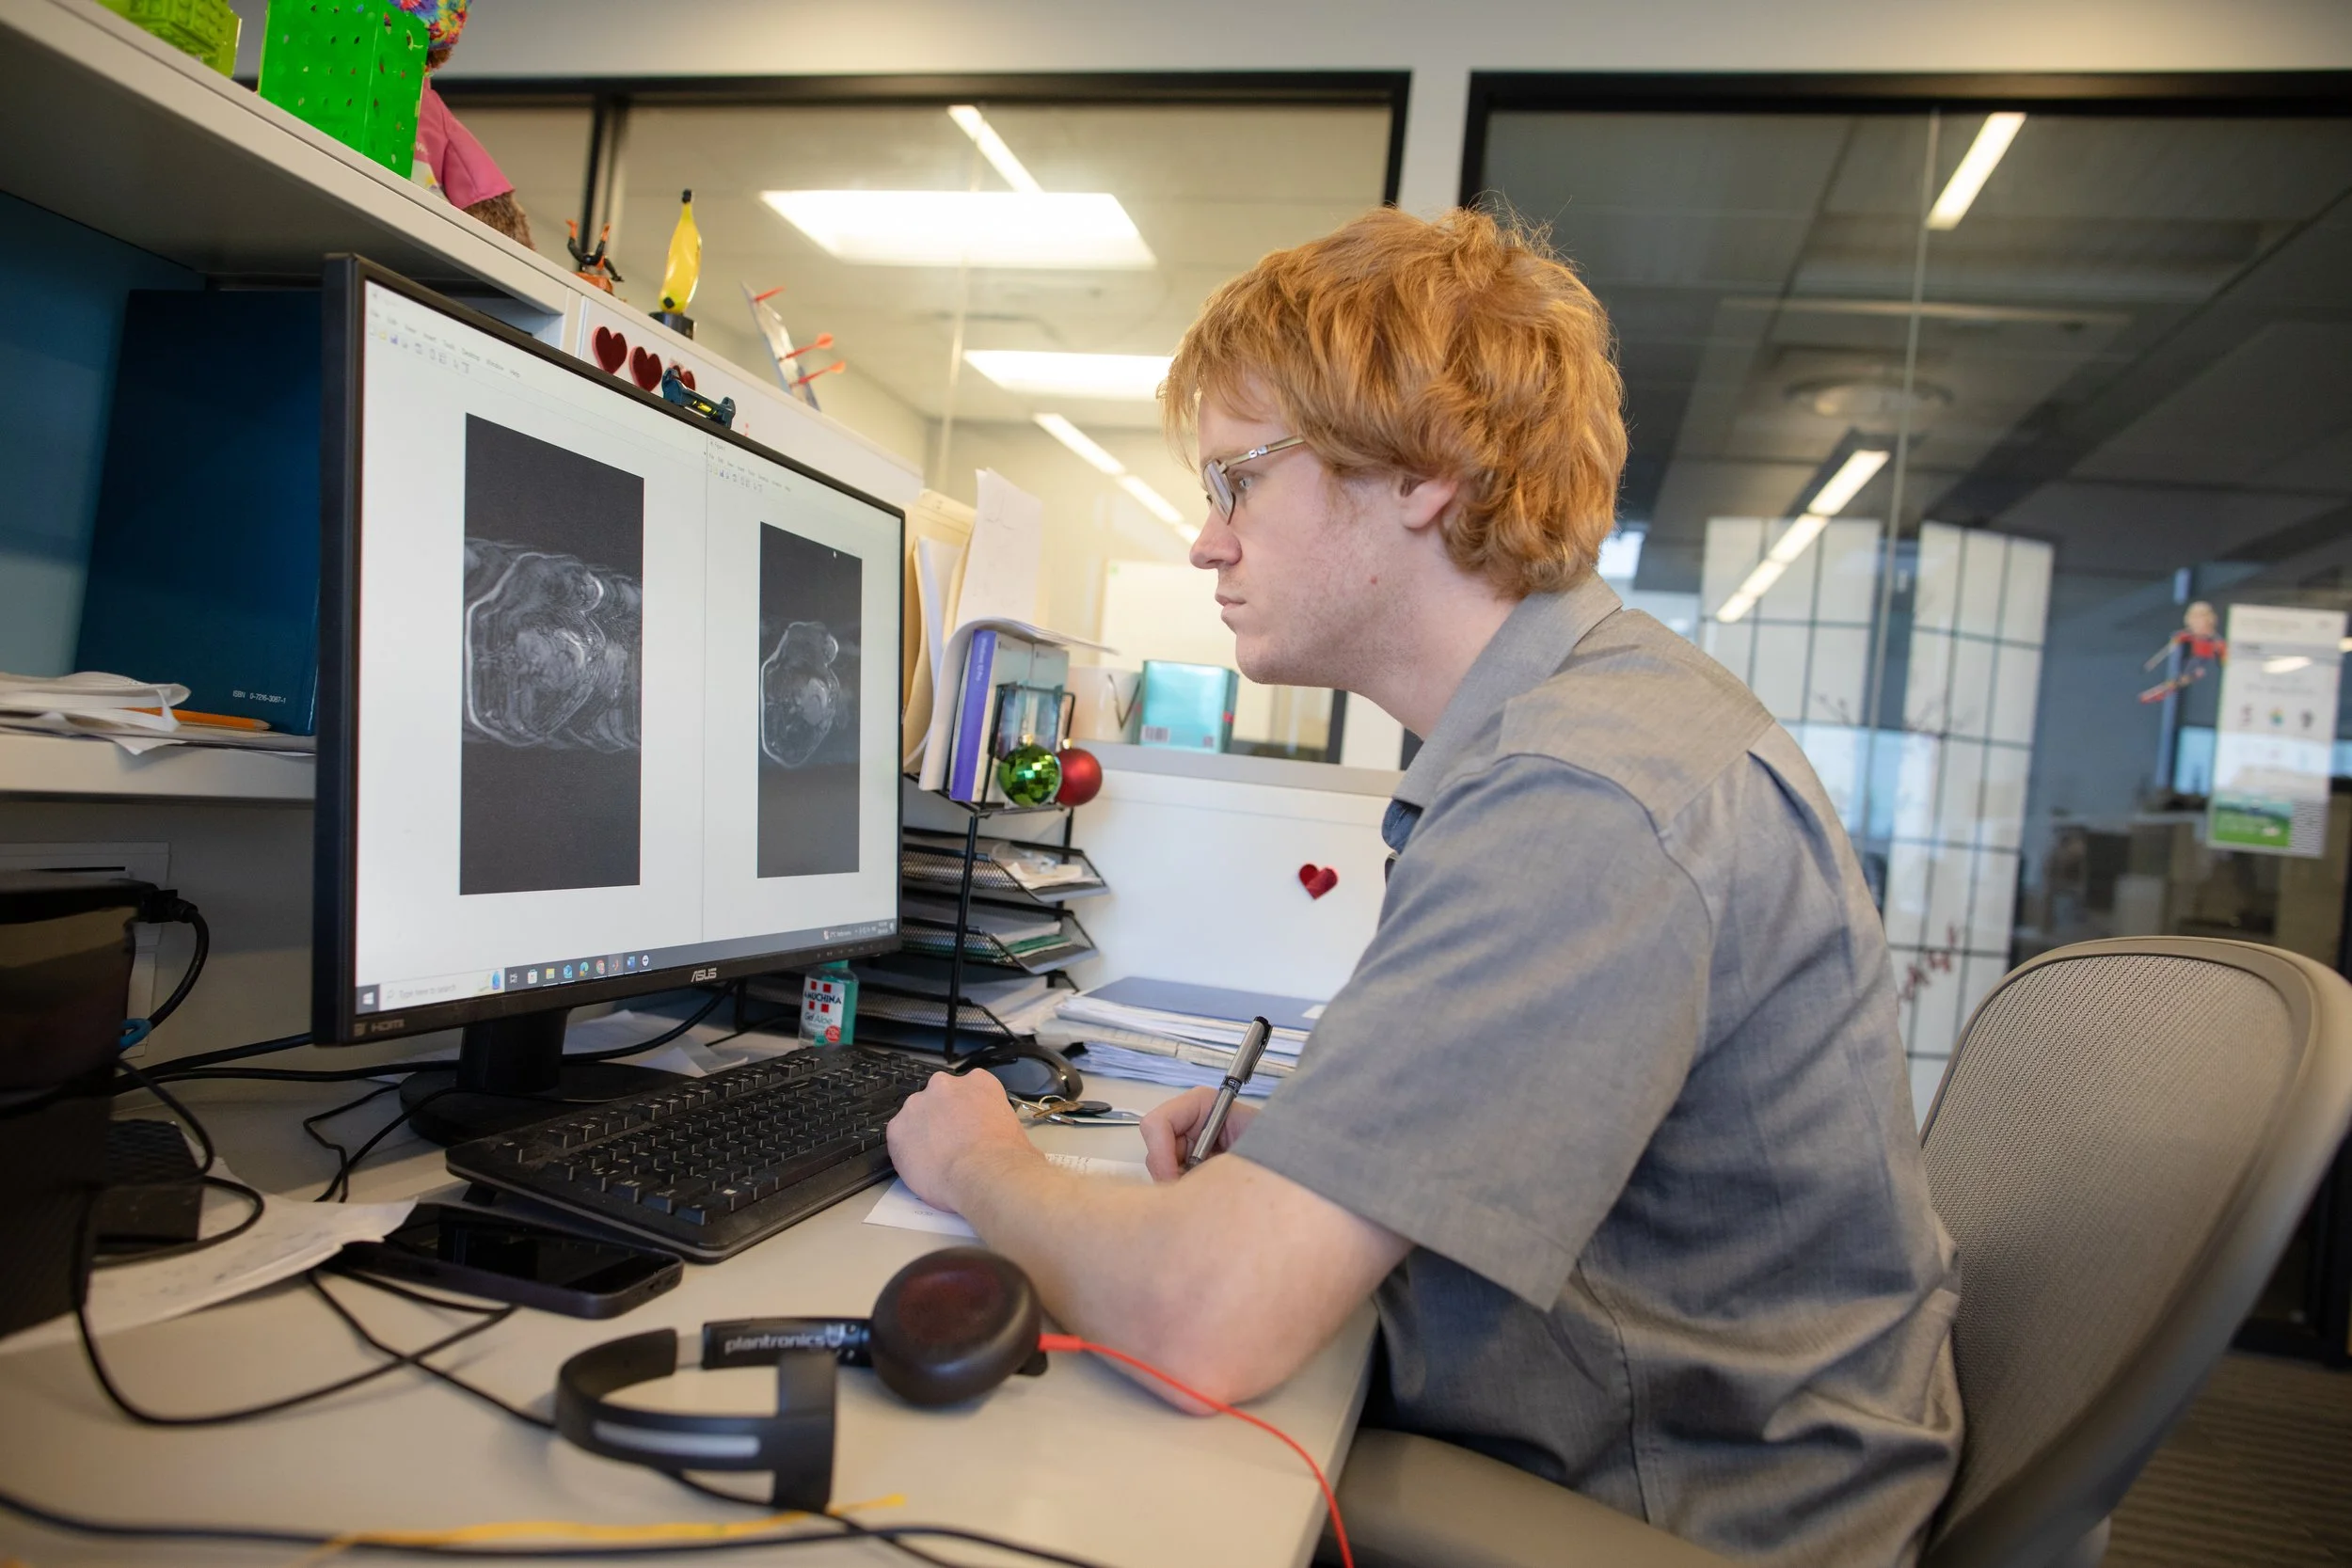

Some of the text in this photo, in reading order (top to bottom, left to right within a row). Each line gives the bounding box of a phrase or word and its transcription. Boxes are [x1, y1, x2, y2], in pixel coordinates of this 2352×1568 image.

[691, 967, 717, 983] ASUS
[804, 990, 842, 1005] AMUCHINA
[724, 1334, 825, 1355] plantronics
